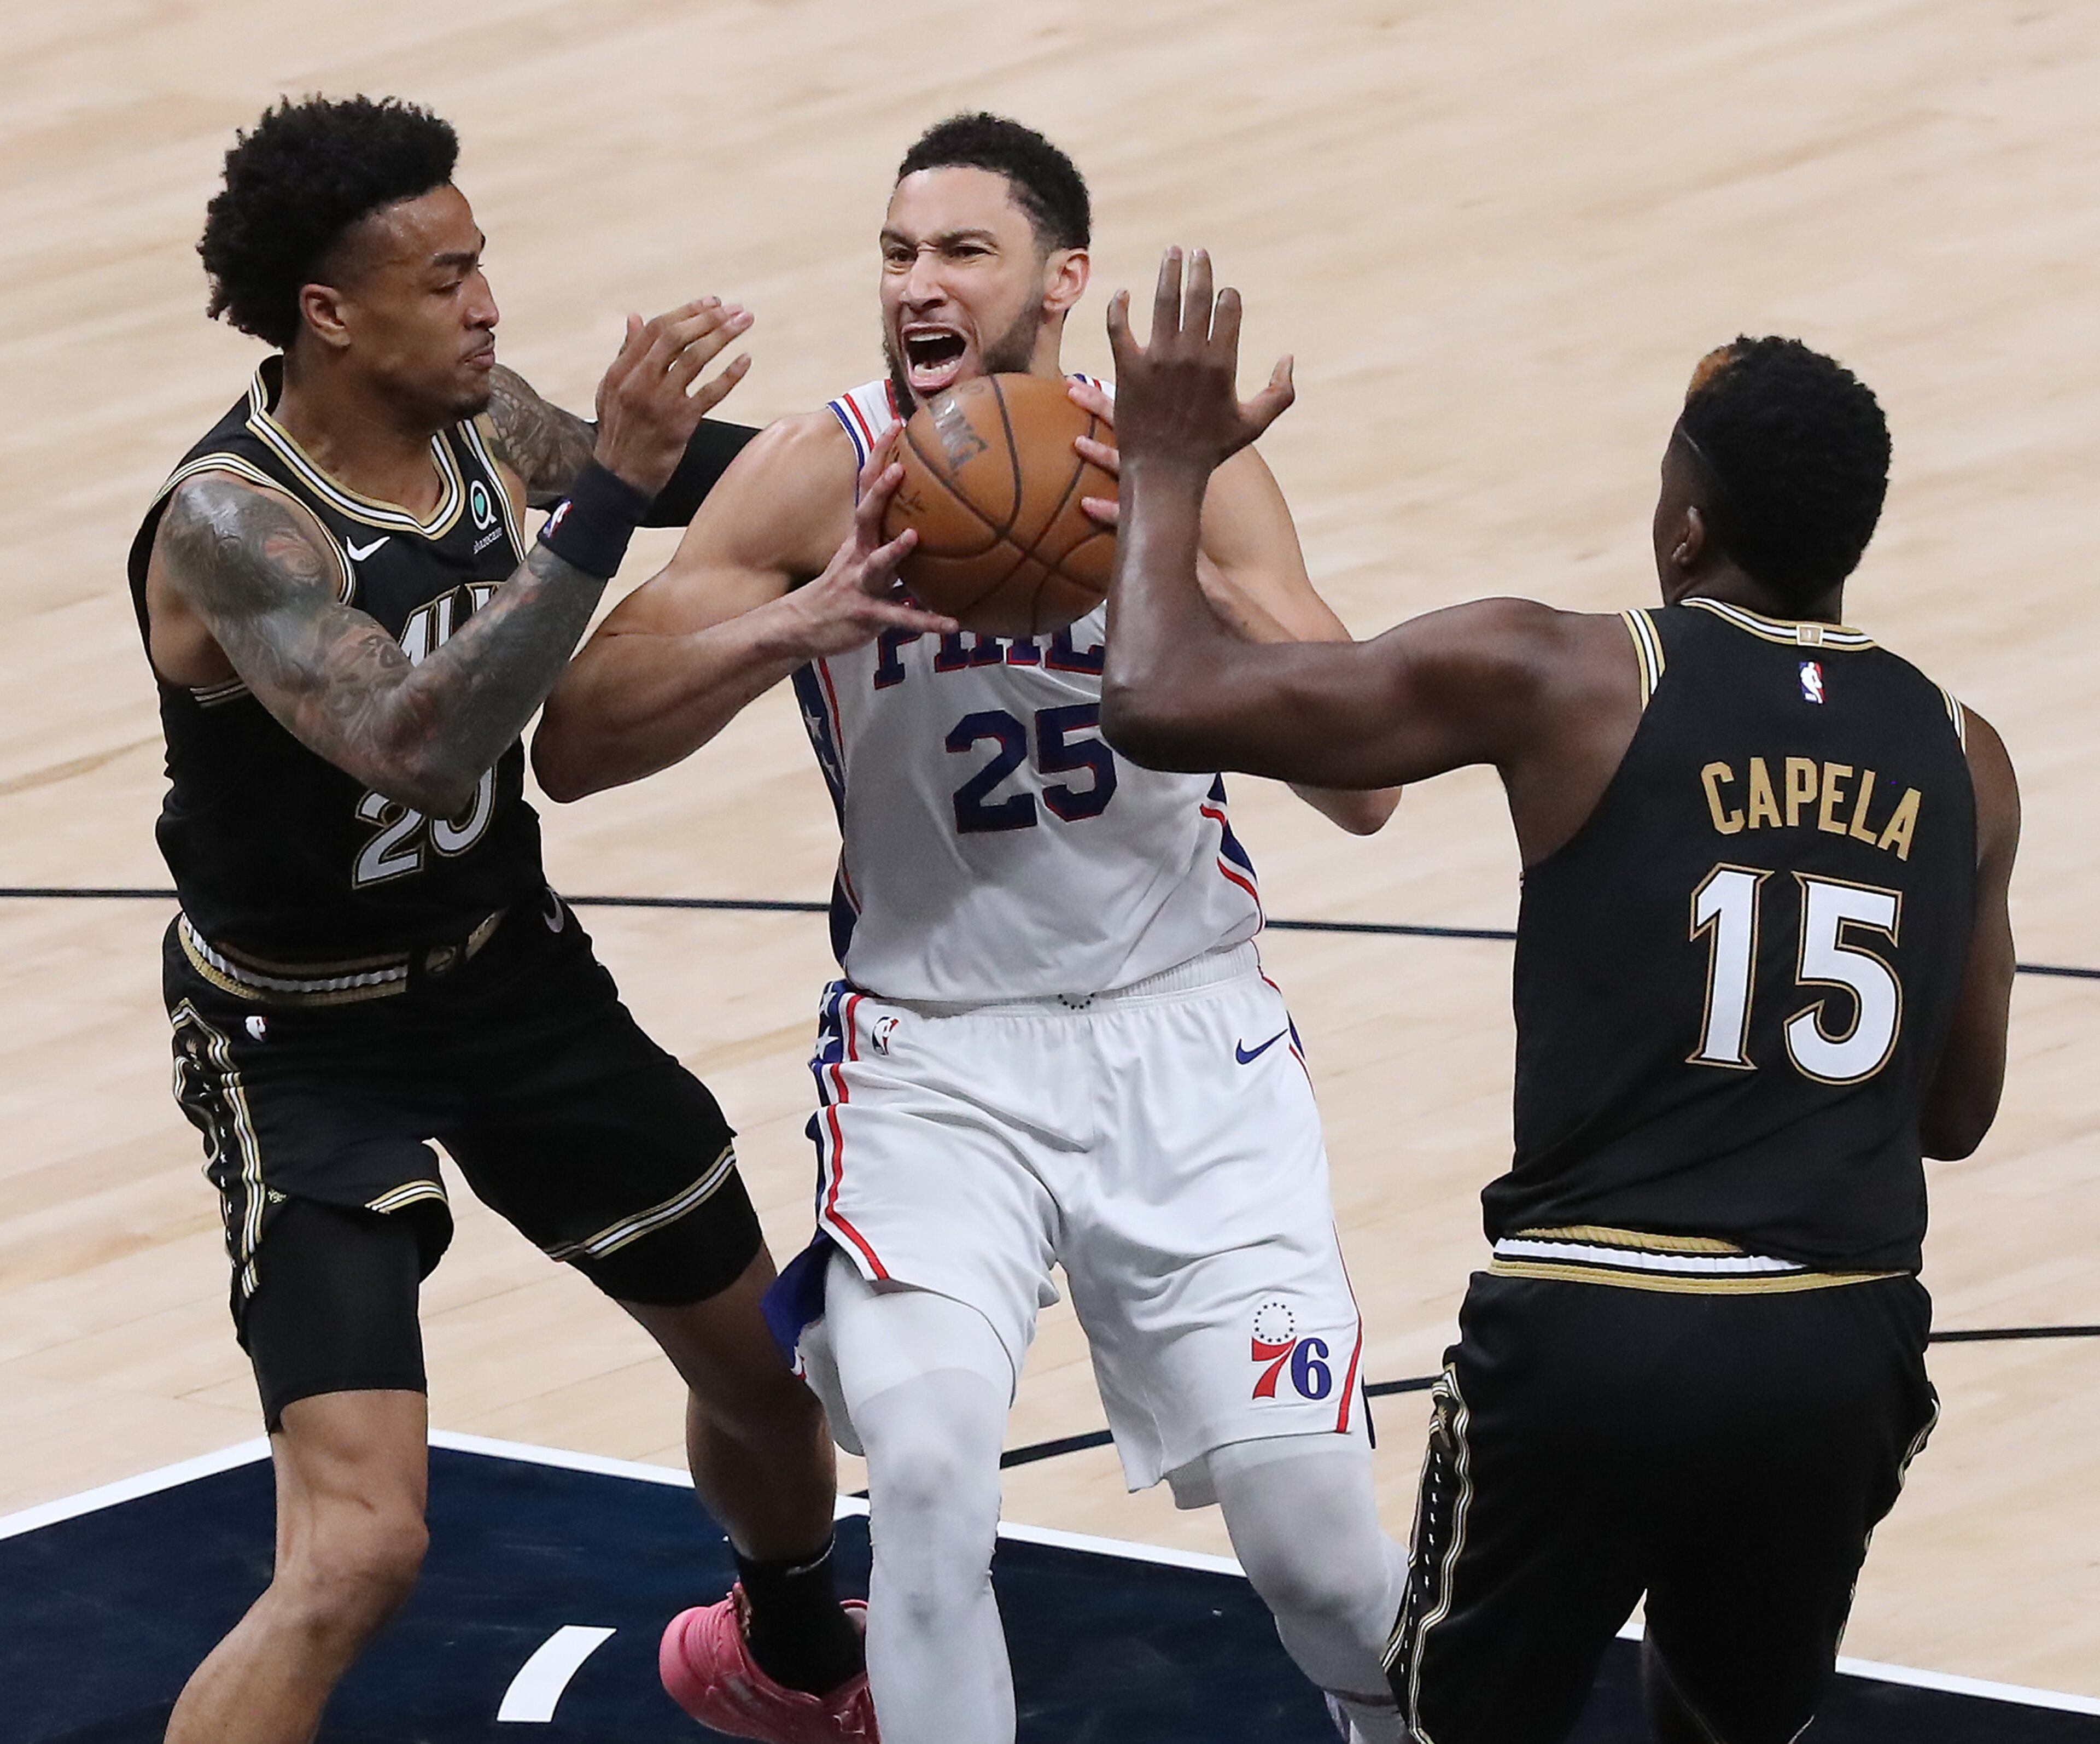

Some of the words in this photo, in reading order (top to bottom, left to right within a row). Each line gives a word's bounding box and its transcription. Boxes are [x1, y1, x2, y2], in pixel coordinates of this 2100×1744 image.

[945, 702, 1117, 834] 25
[1700, 756, 1922, 862] CAPELA
[1685, 862, 1903, 1086] 15
[1251, 1336, 1332, 1401] 76
